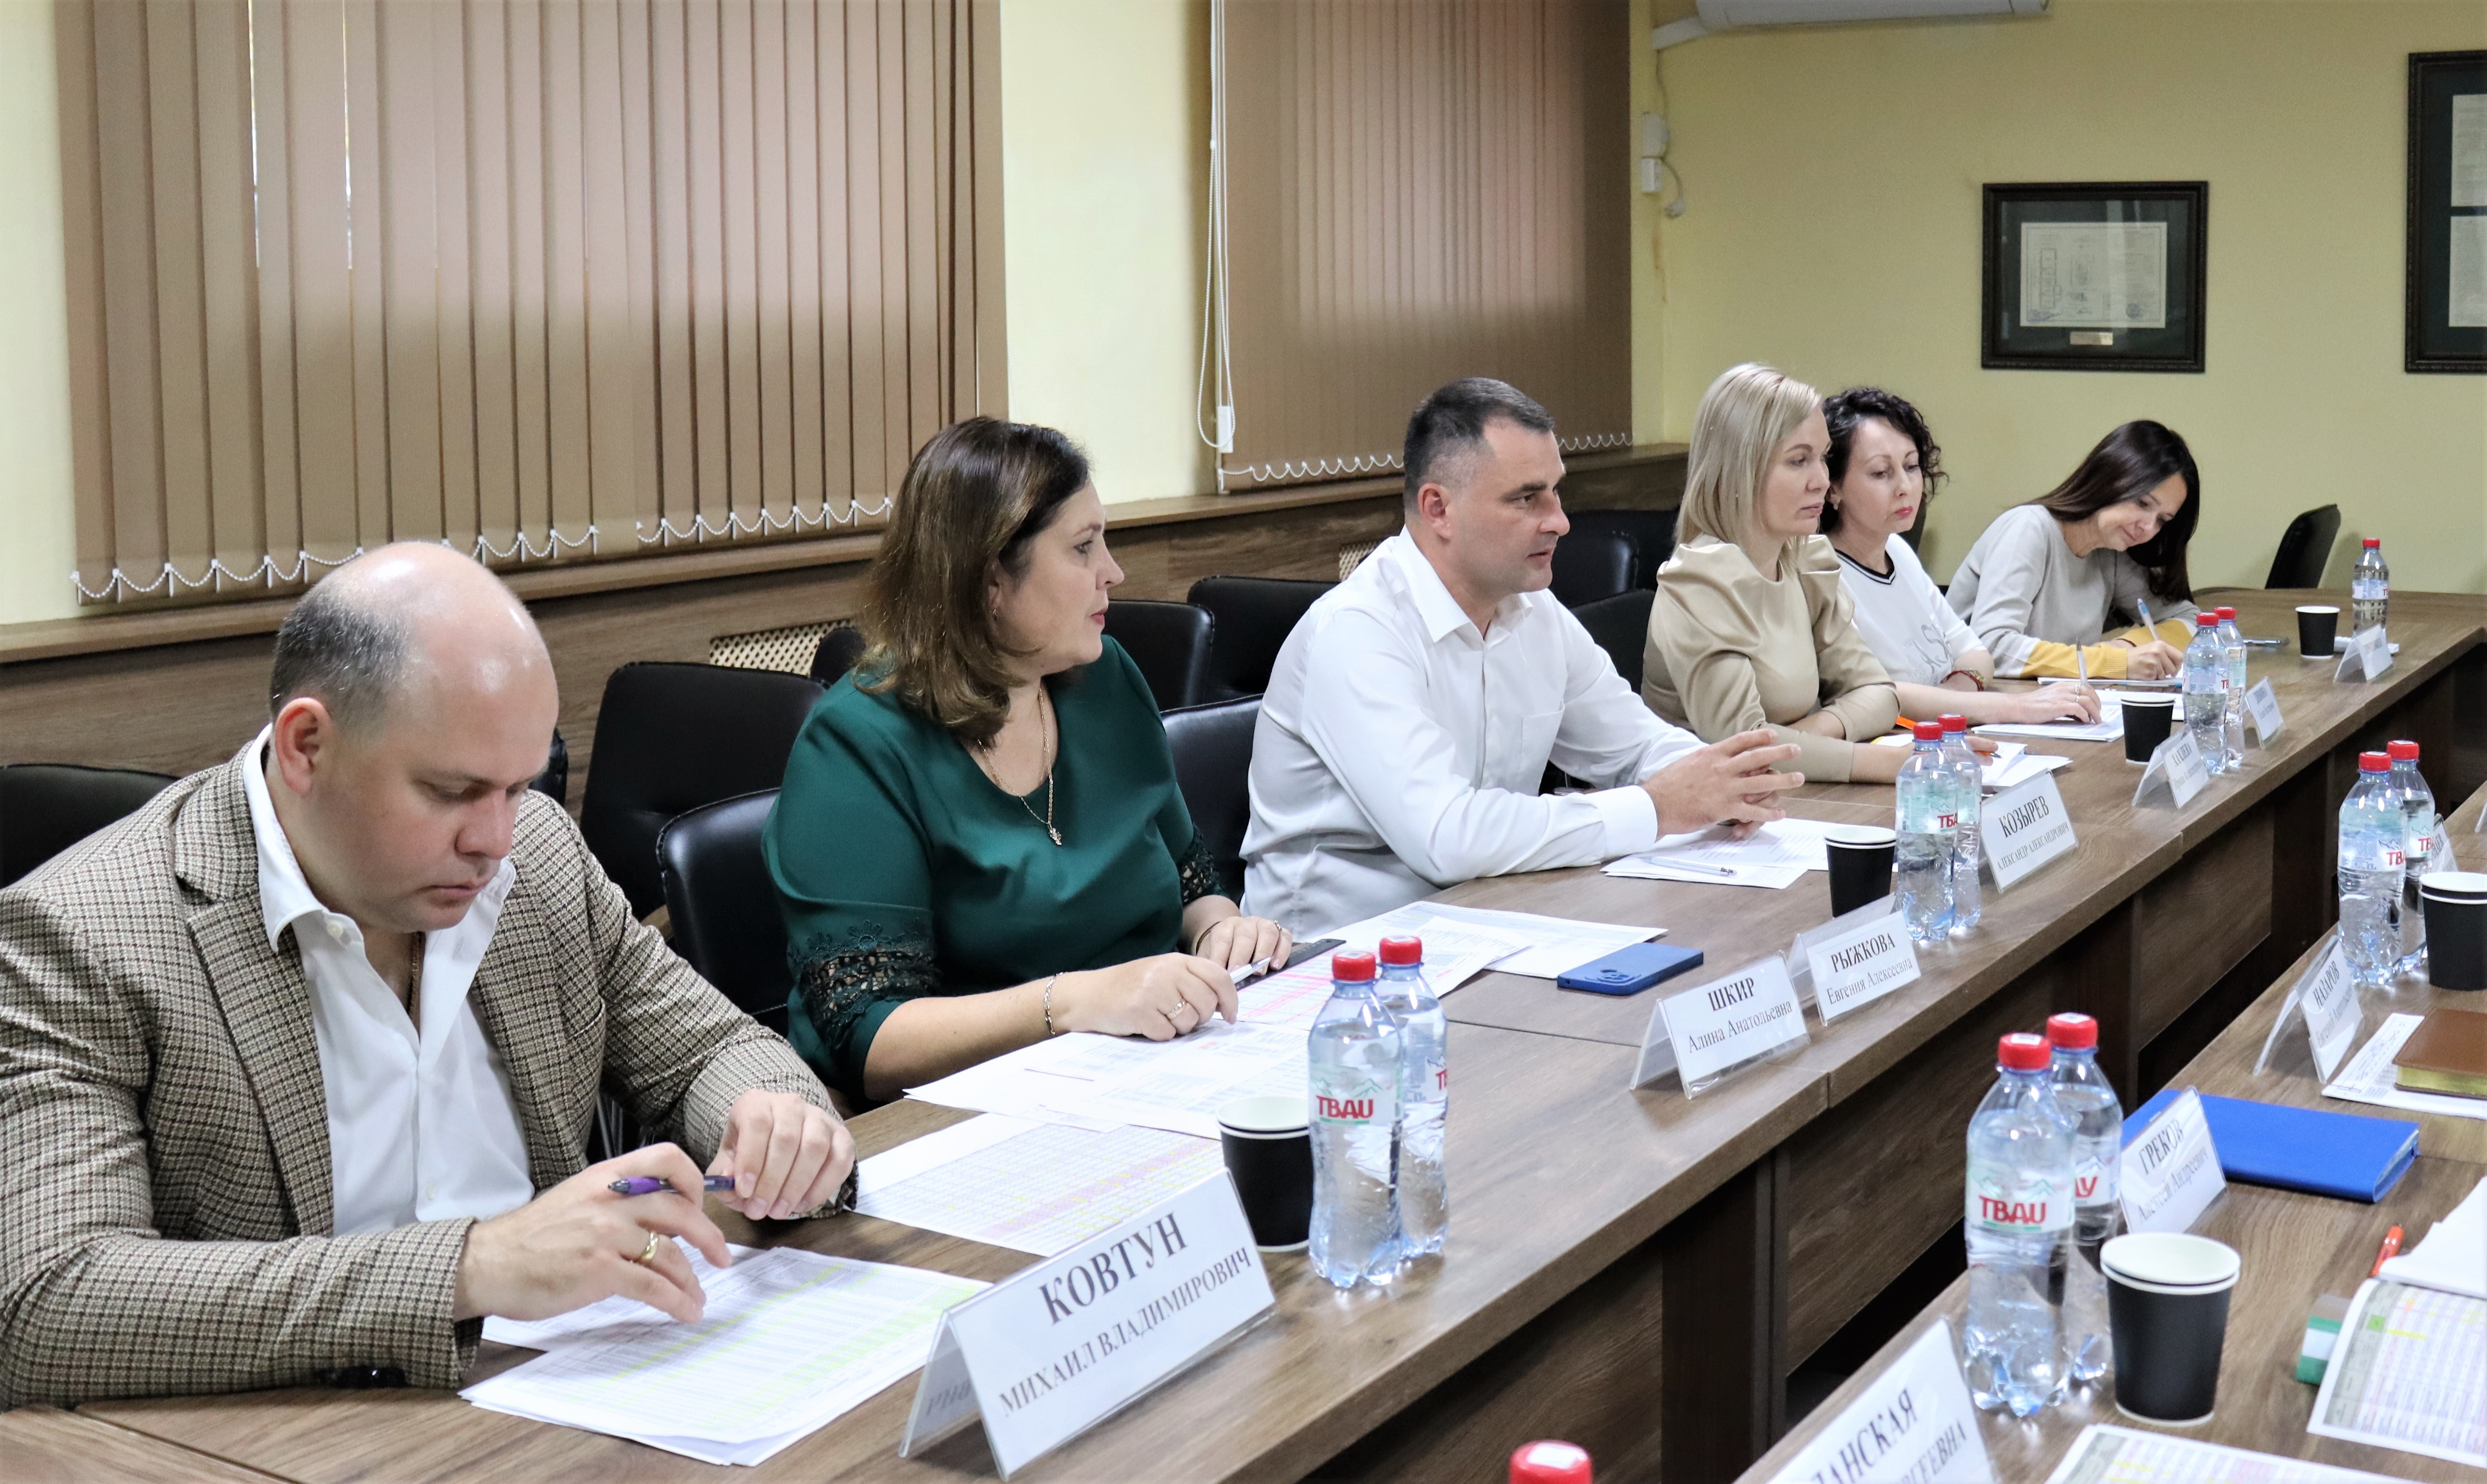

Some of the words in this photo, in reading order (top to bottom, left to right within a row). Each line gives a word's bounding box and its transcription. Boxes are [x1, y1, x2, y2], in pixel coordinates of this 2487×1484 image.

[1998, 796, 2049, 838] КОЗЫРЕВ
[1997, 845, 2028, 871] АЛЕКСАНДР
[2029, 822, 2069, 853] АЛЕКСАНДРОВИЧ
[1830, 932, 1896, 973] РЫЖКОВА
[1707, 978, 1754, 1011] ШКИР
[1827, 979, 1866, 1005] Евгения
[1867, 958, 1913, 988] Алексеевна
[2313, 961, 2340, 1010] НАЗАРОВ
[1689, 1028, 1725, 1053] Алина
[1728, 1001, 1792, 1037] Анатольевна
[2139, 1118, 2184, 1175] ГРЕКОВ
[1038, 1212, 1188, 1325] КОВТУН
[998, 1342, 1098, 1418] МИХАИЛ
[1101, 1246, 1252, 1358] ВЛАДИМИРОВИЧ
